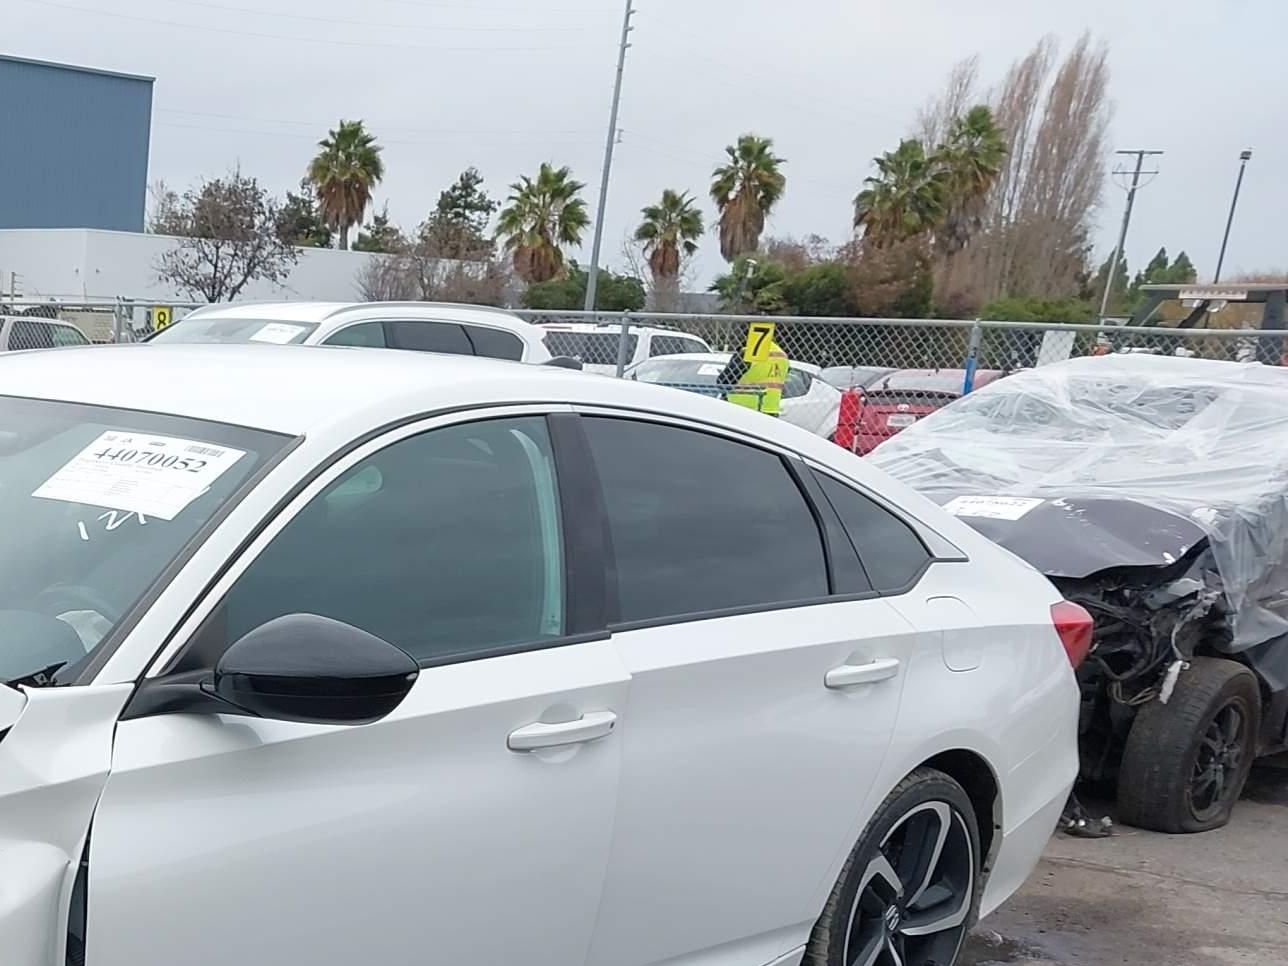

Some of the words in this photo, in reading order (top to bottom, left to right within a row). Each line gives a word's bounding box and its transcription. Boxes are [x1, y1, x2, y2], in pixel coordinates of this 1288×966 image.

[157, 311, 167, 330] 8
[752, 327, 770, 356] 7
[94, 447, 208, 473] 44070052
